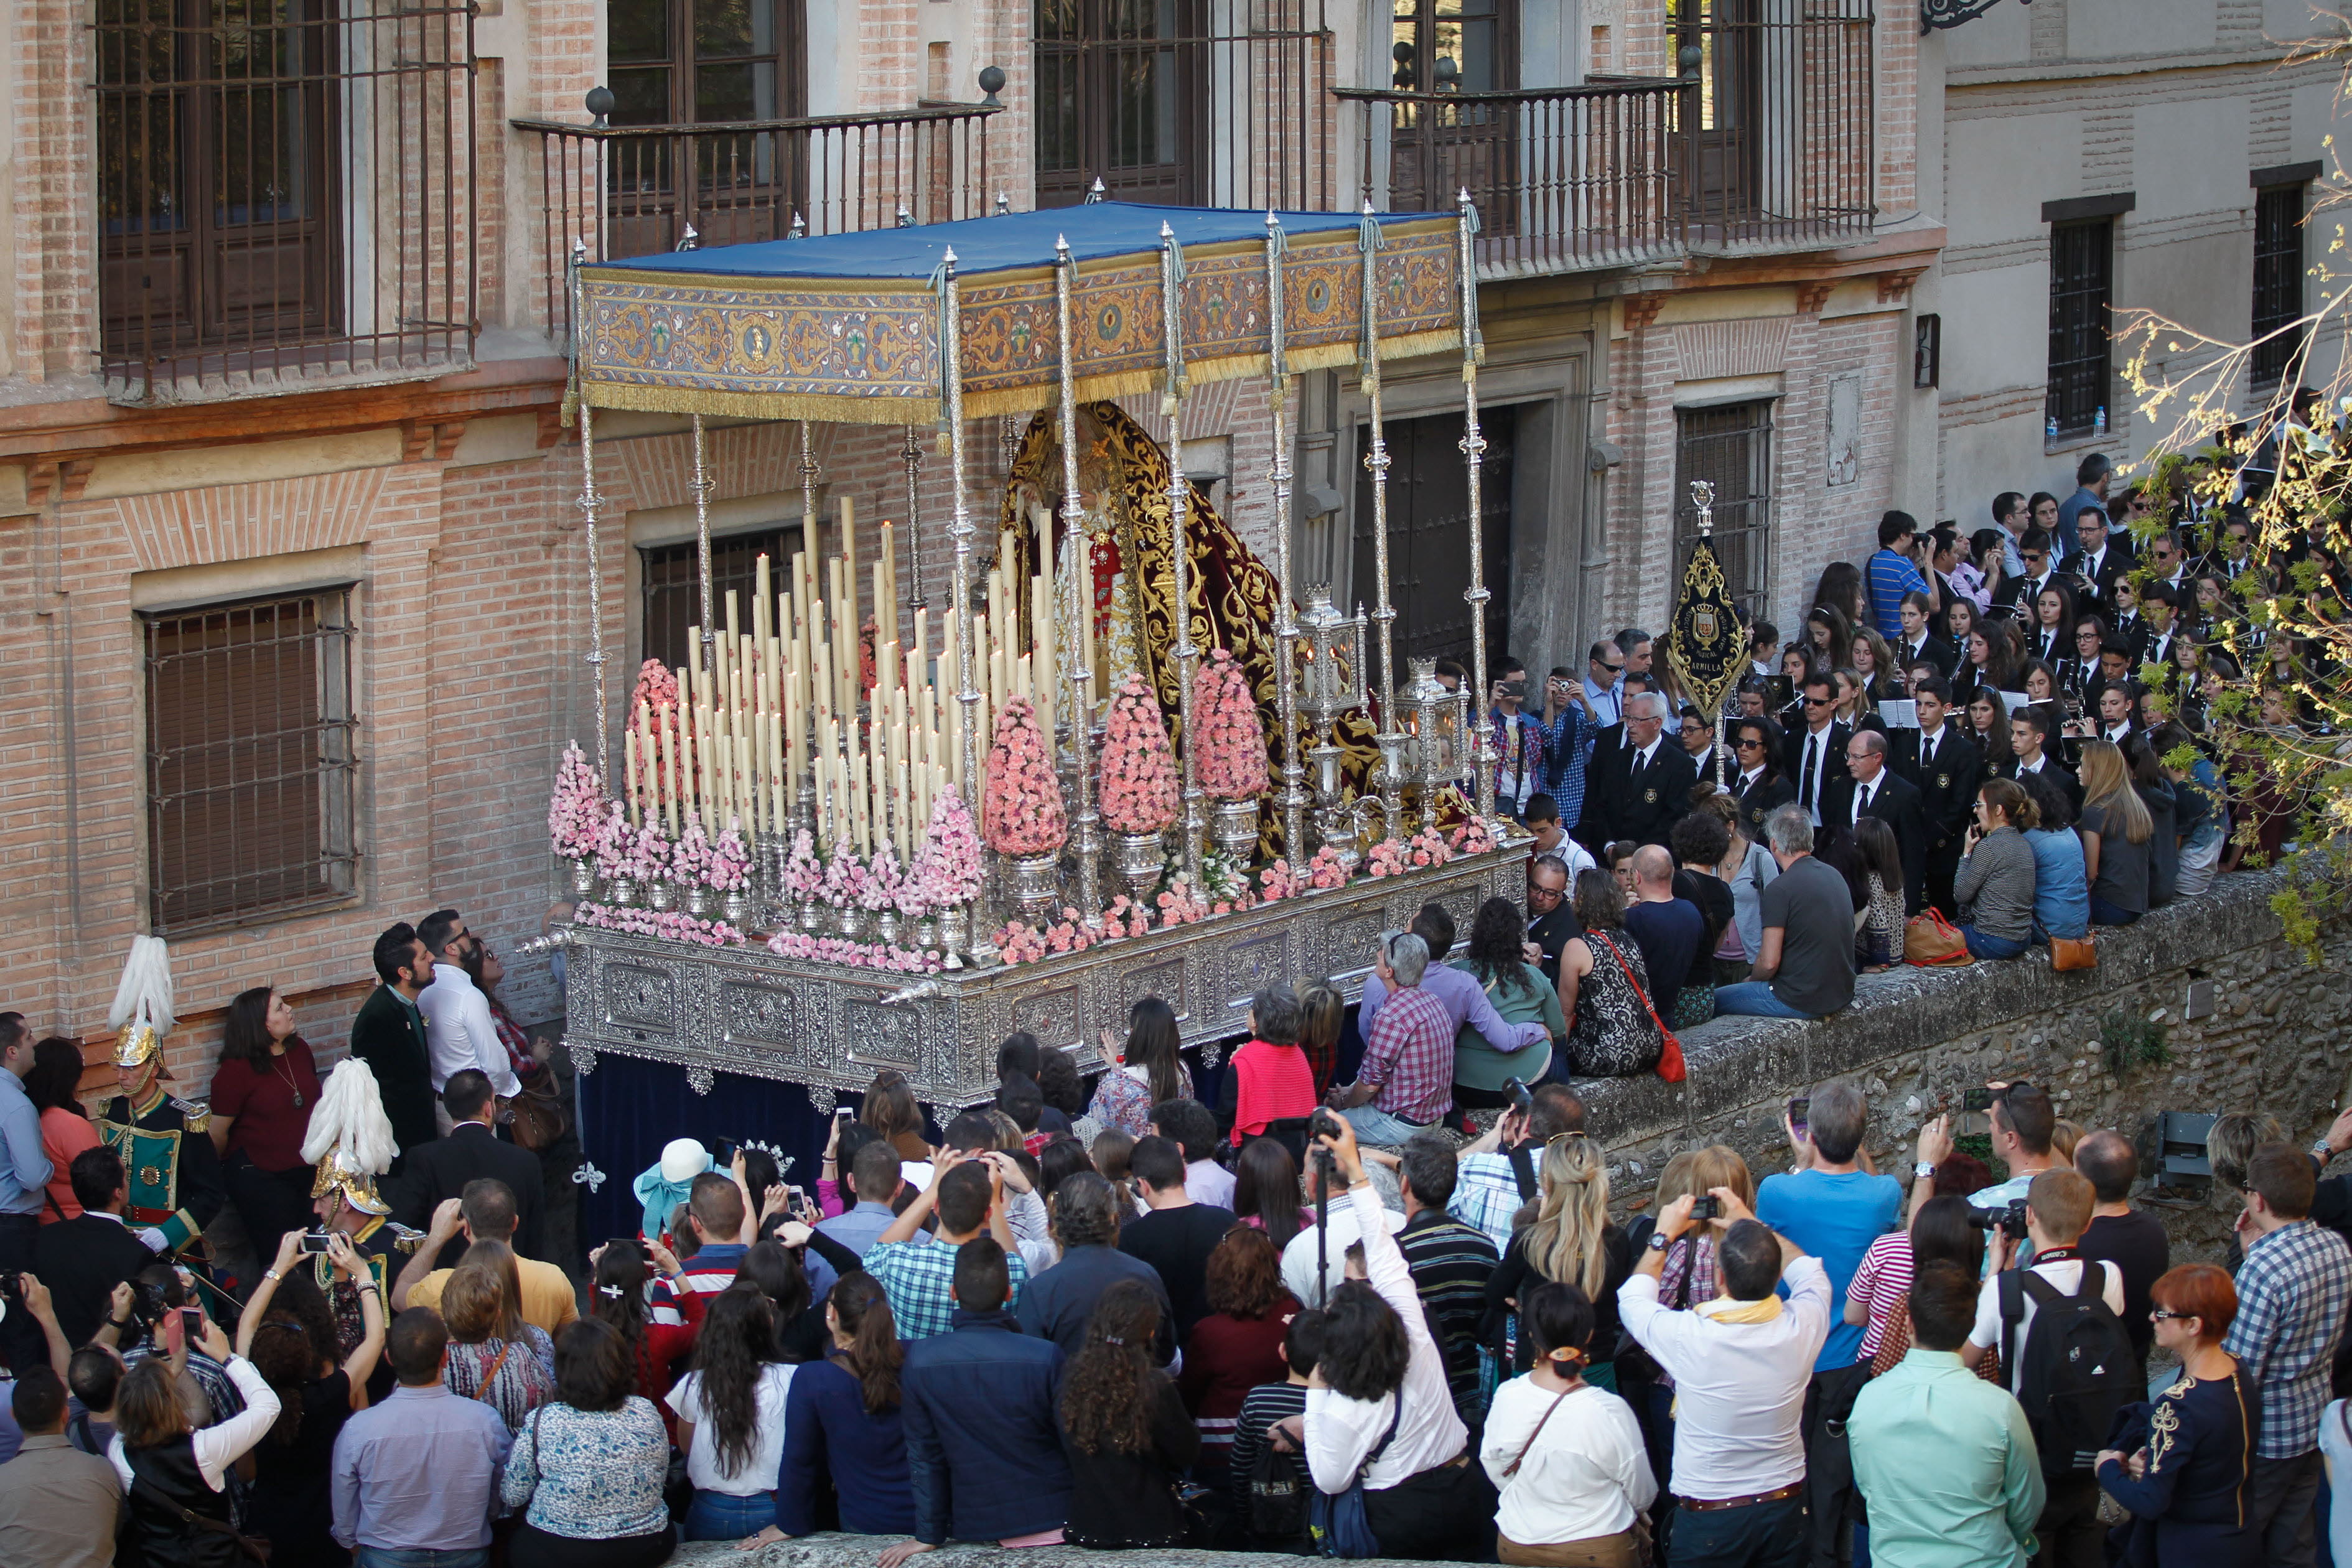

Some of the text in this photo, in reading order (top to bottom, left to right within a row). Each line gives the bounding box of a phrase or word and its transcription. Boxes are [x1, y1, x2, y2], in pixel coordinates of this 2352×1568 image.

[1719, 610, 1727, 633] ISIDRO
[1684, 609, 1696, 649] ASOCIACION
[1719, 637, 1727, 651] SAN
[1692, 663, 1722, 671] ARMILLA
[2041, 1250, 2067, 1261] Canon
